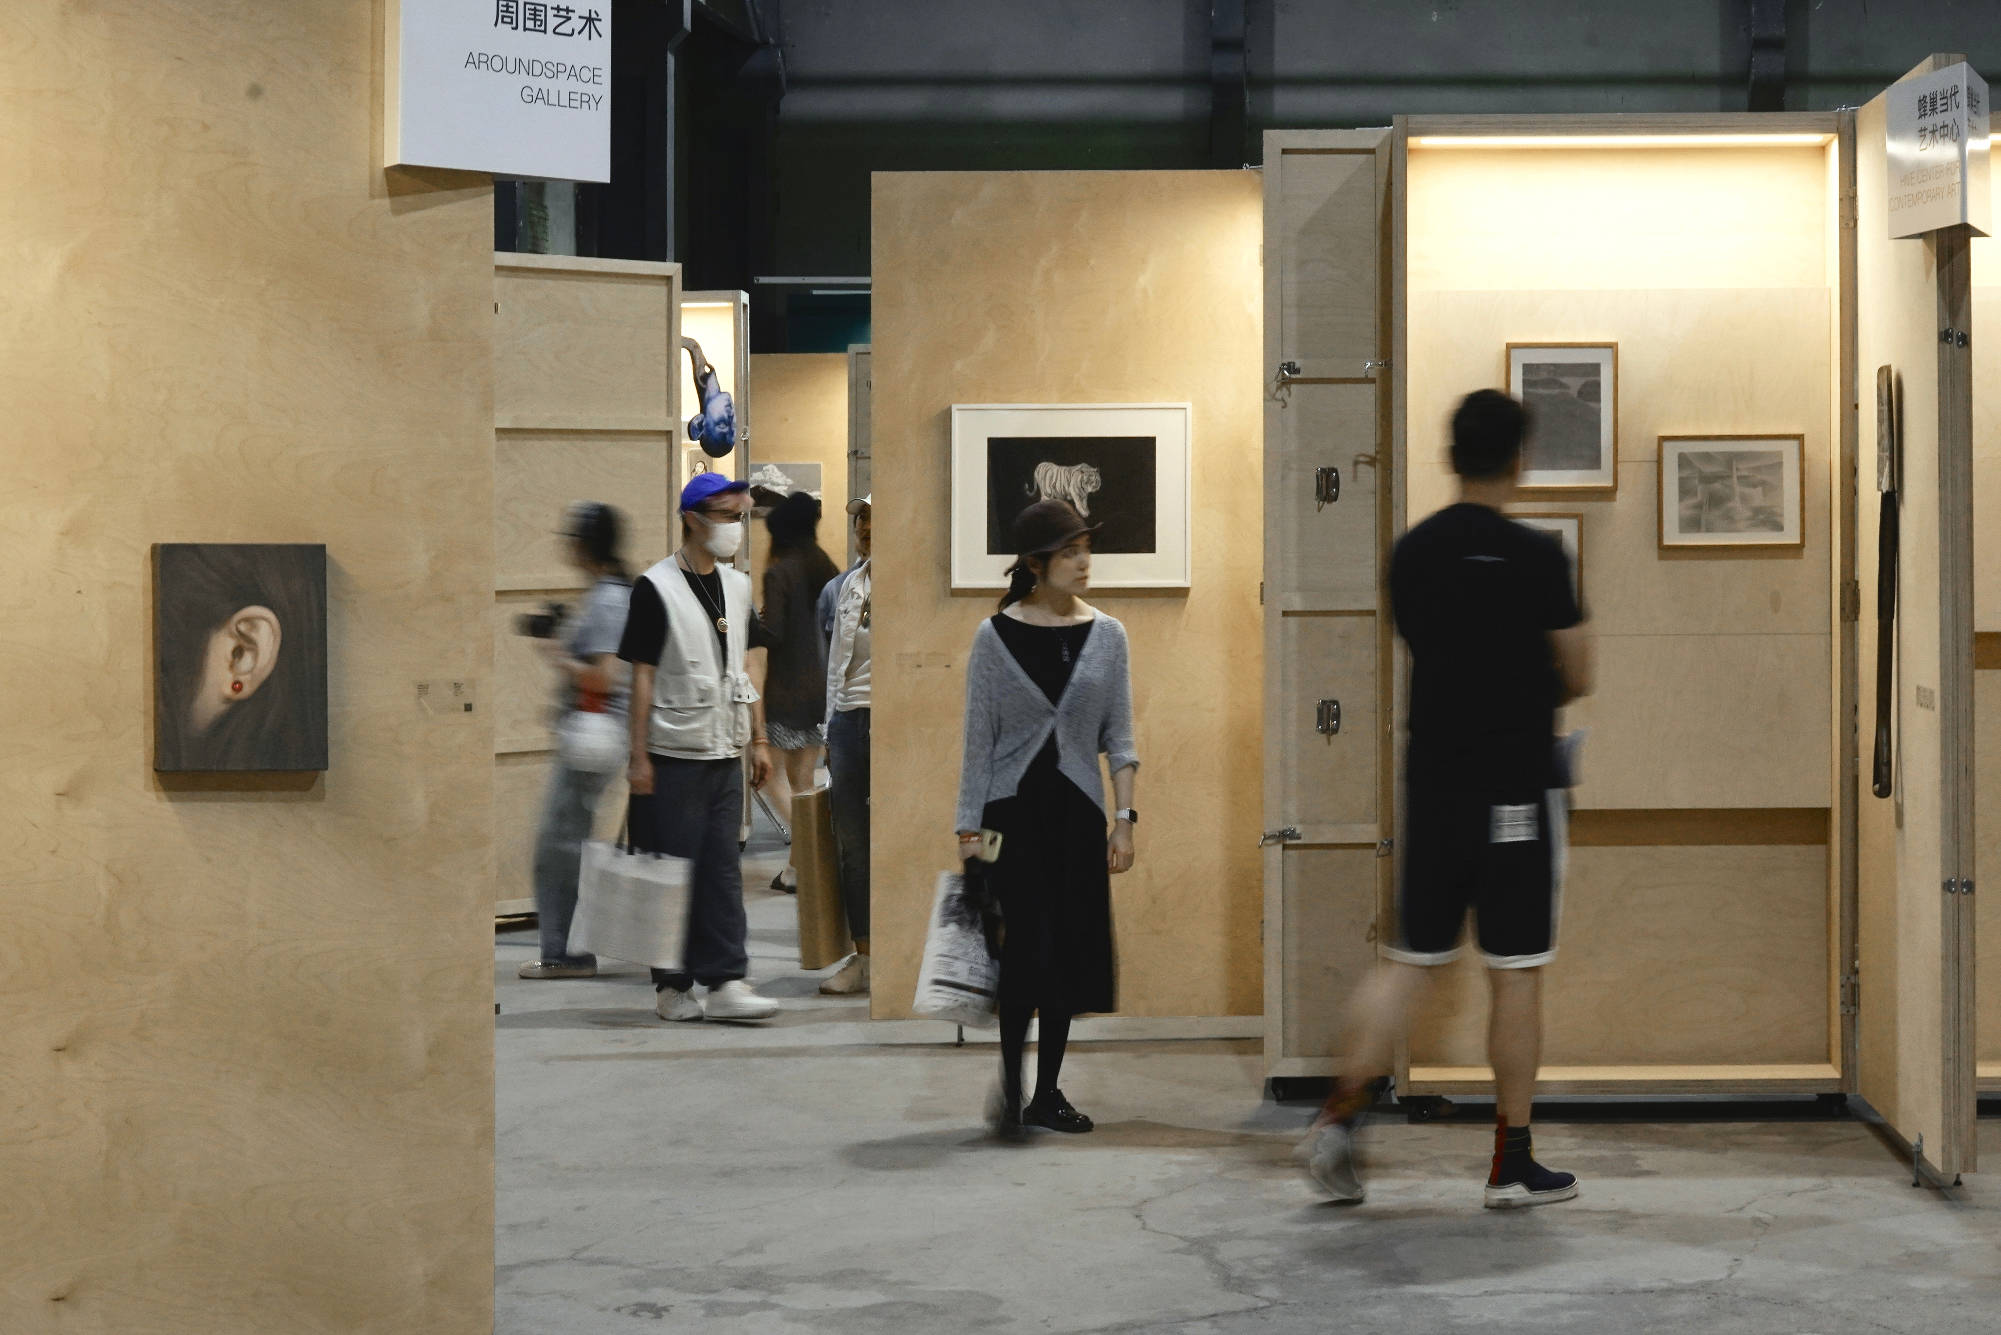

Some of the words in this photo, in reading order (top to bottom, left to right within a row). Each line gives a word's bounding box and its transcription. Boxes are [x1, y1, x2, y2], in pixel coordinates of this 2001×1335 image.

[493, 0, 603, 41] 周围艺术
[464, 51, 603, 86] AROUNDSPACE
[520, 85, 603, 111] GALLERY
[1917, 84, 1960, 120] 蜂巢当代
[1918, 118, 1960, 152] 艺术中心
